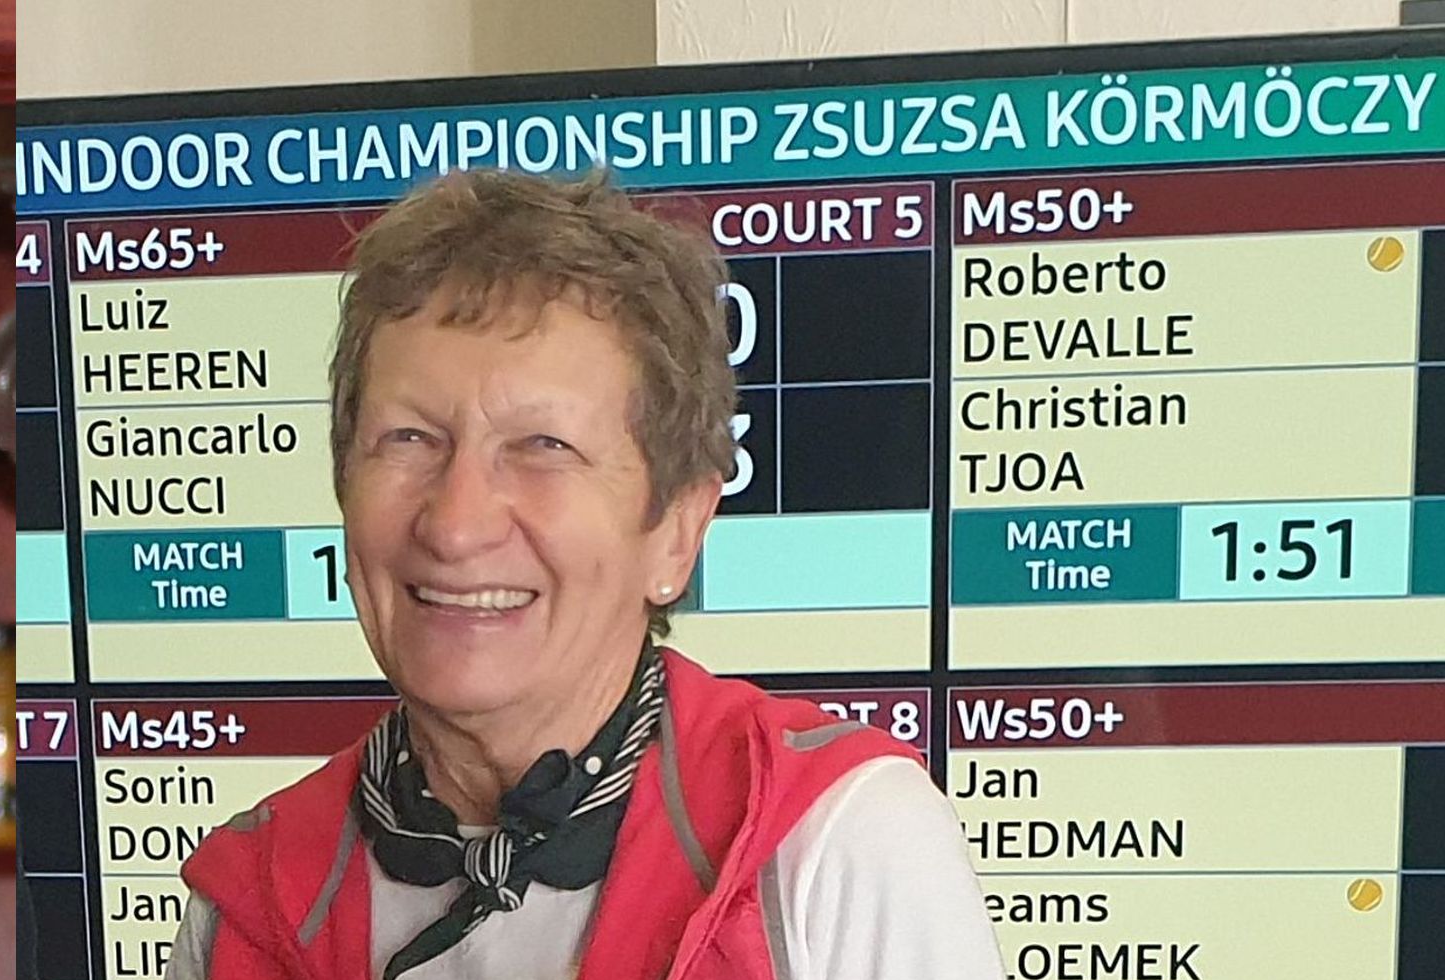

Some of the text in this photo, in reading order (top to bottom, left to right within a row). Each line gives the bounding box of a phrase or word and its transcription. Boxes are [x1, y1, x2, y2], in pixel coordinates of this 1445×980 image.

[16, 65, 1438, 196] INDOOR CHAMPIONSHIP ZSUZSA KÖRMÖCZY
[712, 195, 924, 246] COURT 5
[962, 187, 1134, 236] Ms50+
[75, 227, 225, 273] Ms65+
[963, 251, 1167, 298] Roberto
[80, 288, 171, 331] Luiz
[963, 315, 1195, 362] DEVALLE
[83, 349, 269, 392] HEEREN
[960, 384, 1188, 432] Christian
[87, 414, 298, 457] Giancarlo
[960, 451, 1085, 494] TJOA
[90, 476, 226, 516] NUCCI
[1007, 518, 1133, 552] MATCH
[1211, 518, 1355, 583] 1:51
[133, 542, 244, 571] MATCH
[1026, 560, 1111, 591] Time
[152, 580, 228, 609] Time
[43, 711, 68, 750] 7
[101, 710, 246, 750] Ms45+
[890, 701, 920, 741] 8
[956, 700, 1124, 741] Ws50+
[104, 766, 214, 805] Sorin
[956, 761, 1039, 799] Jan
[961, 820, 1184, 859] HEDMAN
[110, 886, 183, 922] Jan
[984, 893, 1109, 923] eams
